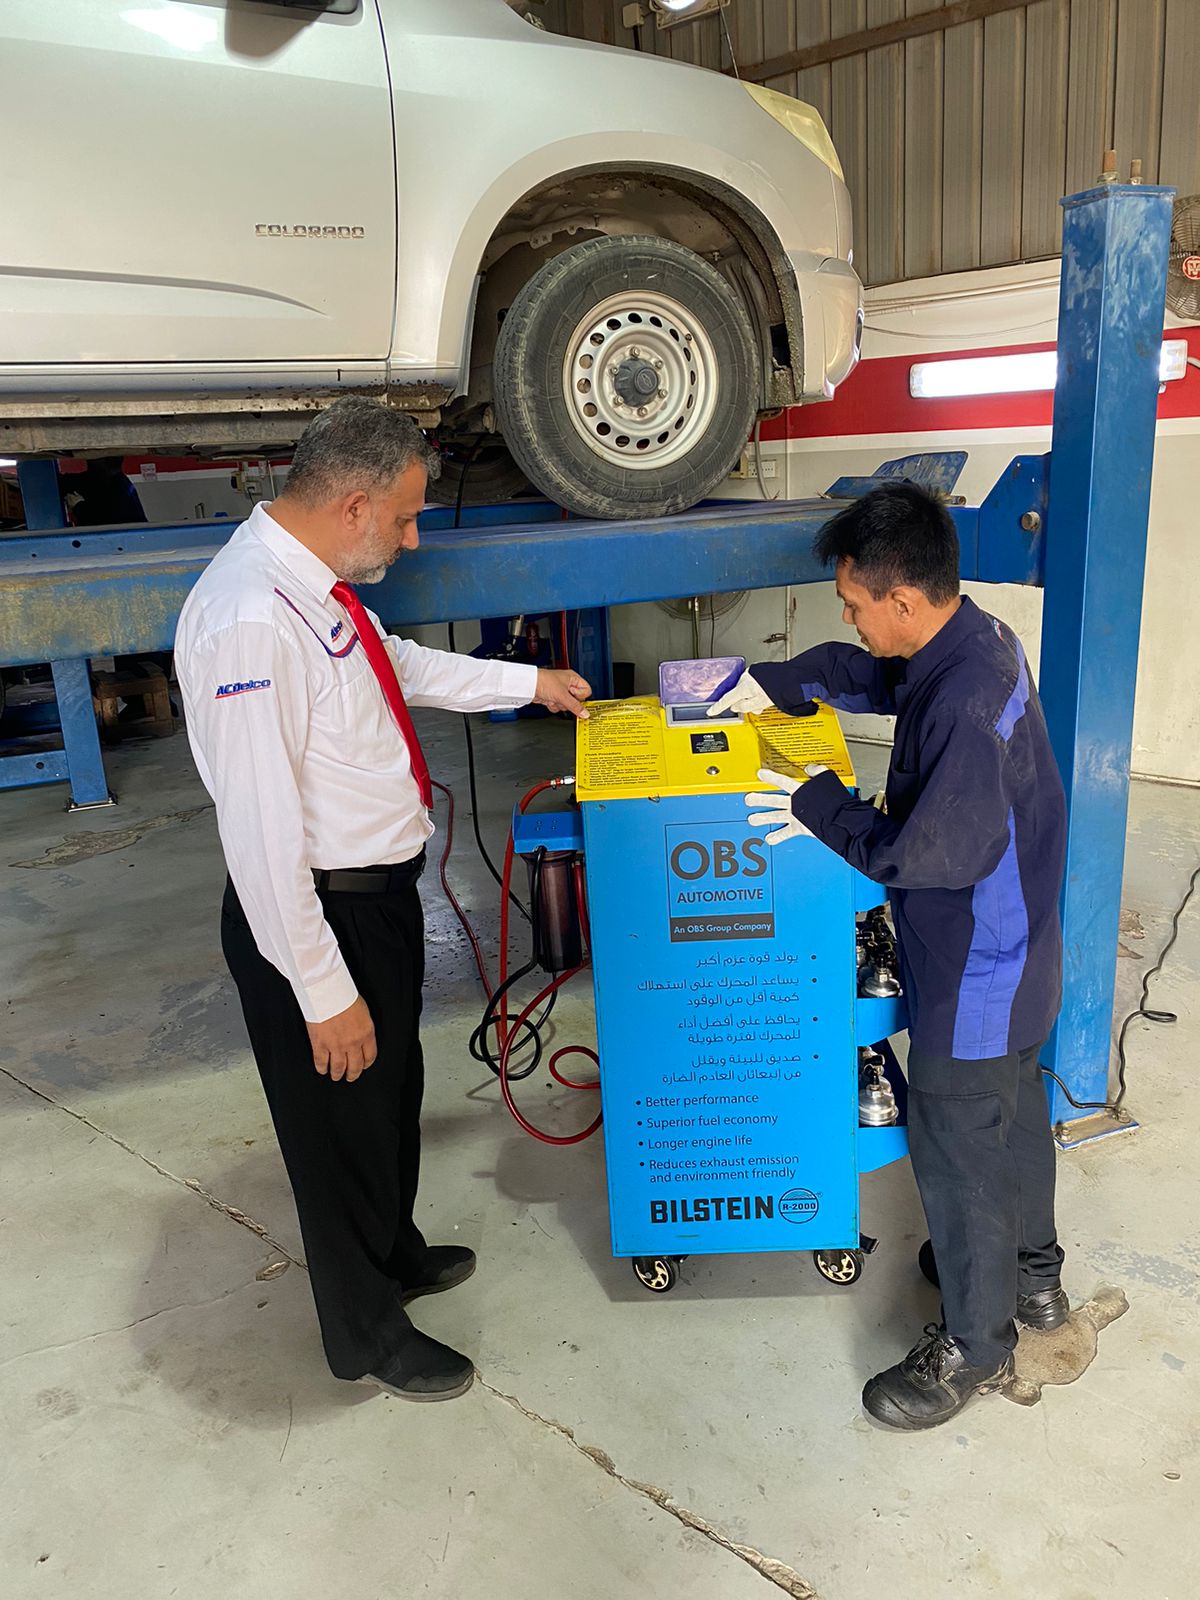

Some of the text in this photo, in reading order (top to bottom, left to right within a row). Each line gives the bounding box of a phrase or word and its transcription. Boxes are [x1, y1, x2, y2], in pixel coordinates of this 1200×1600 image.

[255, 223, 365, 239] COLORADO
[670, 837, 768, 880] OBS
[677, 888, 764, 904] AUTOMOTIVE
[674, 922, 771, 934] An OBS Group Company
[723, 955, 746, 967] عزم
[749, 952, 770, 966] قوة
[690, 978, 714, 991] على
[717, 976, 757, 990] المحرك
[761, 975, 799, 987] يساعد
[687, 989, 800, 1008] كمية أقل من الوقود
[678, 1013, 801, 1030] يحافظ على أفضل أداء
[687, 1029, 801, 1046] للمحرك لفترة طويلة
[692, 1055, 726, 1068] ويقلل
[766, 1053, 801, 1065] صديق
[662, 1071, 696, 1086] الضارة
[699, 1070, 735, 1085] العادم
[784, 1070, 802, 1081] من
[646, 1093, 759, 1108] Better performance
[647, 1114, 778, 1130] Superior fuel economy
[648, 1134, 753, 1151] Longer engine life
[649, 1154, 799, 1170] Reduces exhaust emission
[650, 1167, 796, 1183] and environment friendly
[650, 1195, 816, 1224] BILSTEIN R-2000
